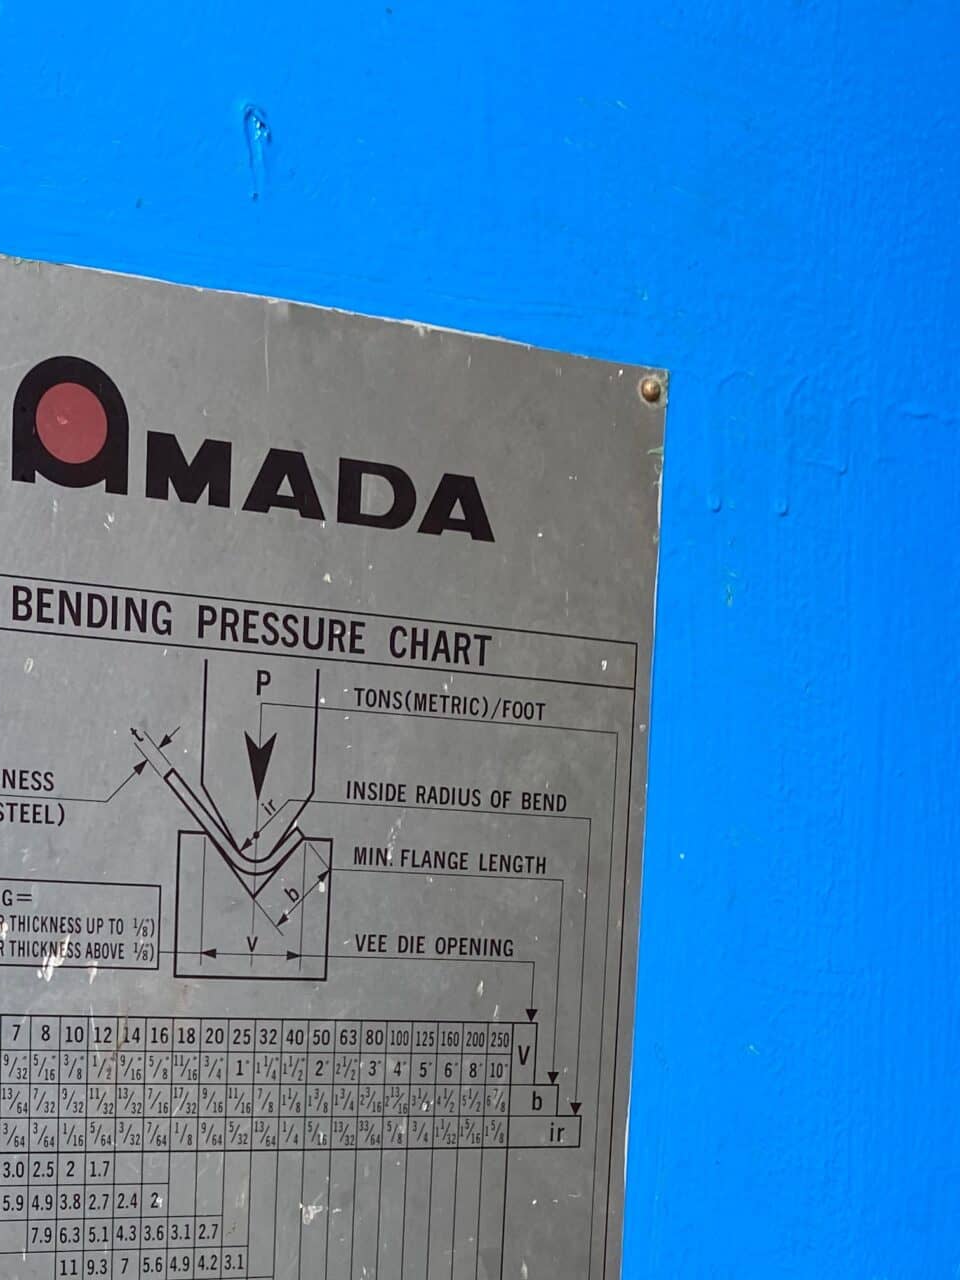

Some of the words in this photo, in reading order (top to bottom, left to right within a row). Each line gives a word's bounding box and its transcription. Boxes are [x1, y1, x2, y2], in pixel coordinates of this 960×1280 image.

[11, 355, 496, 543] AMADA
[12, 585, 172, 636] BENDING
[198, 604, 366, 654] PRESSURE
[389, 625, 492, 666] CHART
[256, 669, 271, 696] P
[353, 687, 546, 721] TONS(METRIC)/FOOT
[346, 780, 407, 803] INSIDE
[416, 785, 481, 807] RADIUS
[490, 790, 512, 809] OF
[521, 792, 567, 812] BEND
[400, 849, 469, 870] FLANGE
[479, 853, 546, 875] LENGTH
[9, 915, 82, 934] THICKNESS
[86, 917, 104, 934] UP
[108, 918, 124, 935] TO
[85, 942, 125, 960] ABOVE
[355, 934, 388, 953] VEE
[398, 935, 425, 954] DIE
[435, 937, 513, 957] OPENING
[12, 1024, 21, 1041] 7
[41, 1024, 50, 1042] 8
[65, 1026, 84, 1043] 10
[94, 1026, 112, 1044] 12
[122, 1026, 140, 1043] 14
[151, 1027, 169, 1044] 16
[178, 1027, 195, 1044] 18
[205, 1027, 224, 1044] 20
[233, 1028, 251, 1045] 25
[259, 1028, 277, 1045] 32
[286, 1029, 304, 1046] 40
[313, 1029, 330, 1046] 50
[340, 1029, 357, 1045] 63
[366, 1029, 384, 1046] 80
[390, 1030, 409, 1046] 100
[416, 1031, 434, 1047] 125
[441, 1031, 460, 1047] 160
[466, 1031, 485, 1048] 200
[490, 1032, 510, 1048] 250
[3, 1161, 24, 1178] 3.0
[32, 1161, 54, 1178] 2.5
[66, 1160, 75, 1177] 2
[90, 1160, 110, 1177] 1.7
[3, 1194, 24, 1211] 5.9
[31, 1194, 53, 1211] 4.9
[60, 1193, 81, 1210] 3.8
[88, 1193, 109, 1210] 2.7
[117, 1193, 138, 1209] 2.4
[150, 1192, 159, 1208] 2
[60, 1259, 78, 1276] 11
[87, 1258, 107, 1276] 9.3
[121, 1258, 129, 1274] 7
[143, 1256, 163, 1273] 5.6
[169, 1256, 190, 1272] 4.9
[198, 1254, 218, 1271] 4.2
[224, 1254, 244, 1270] 3.1
